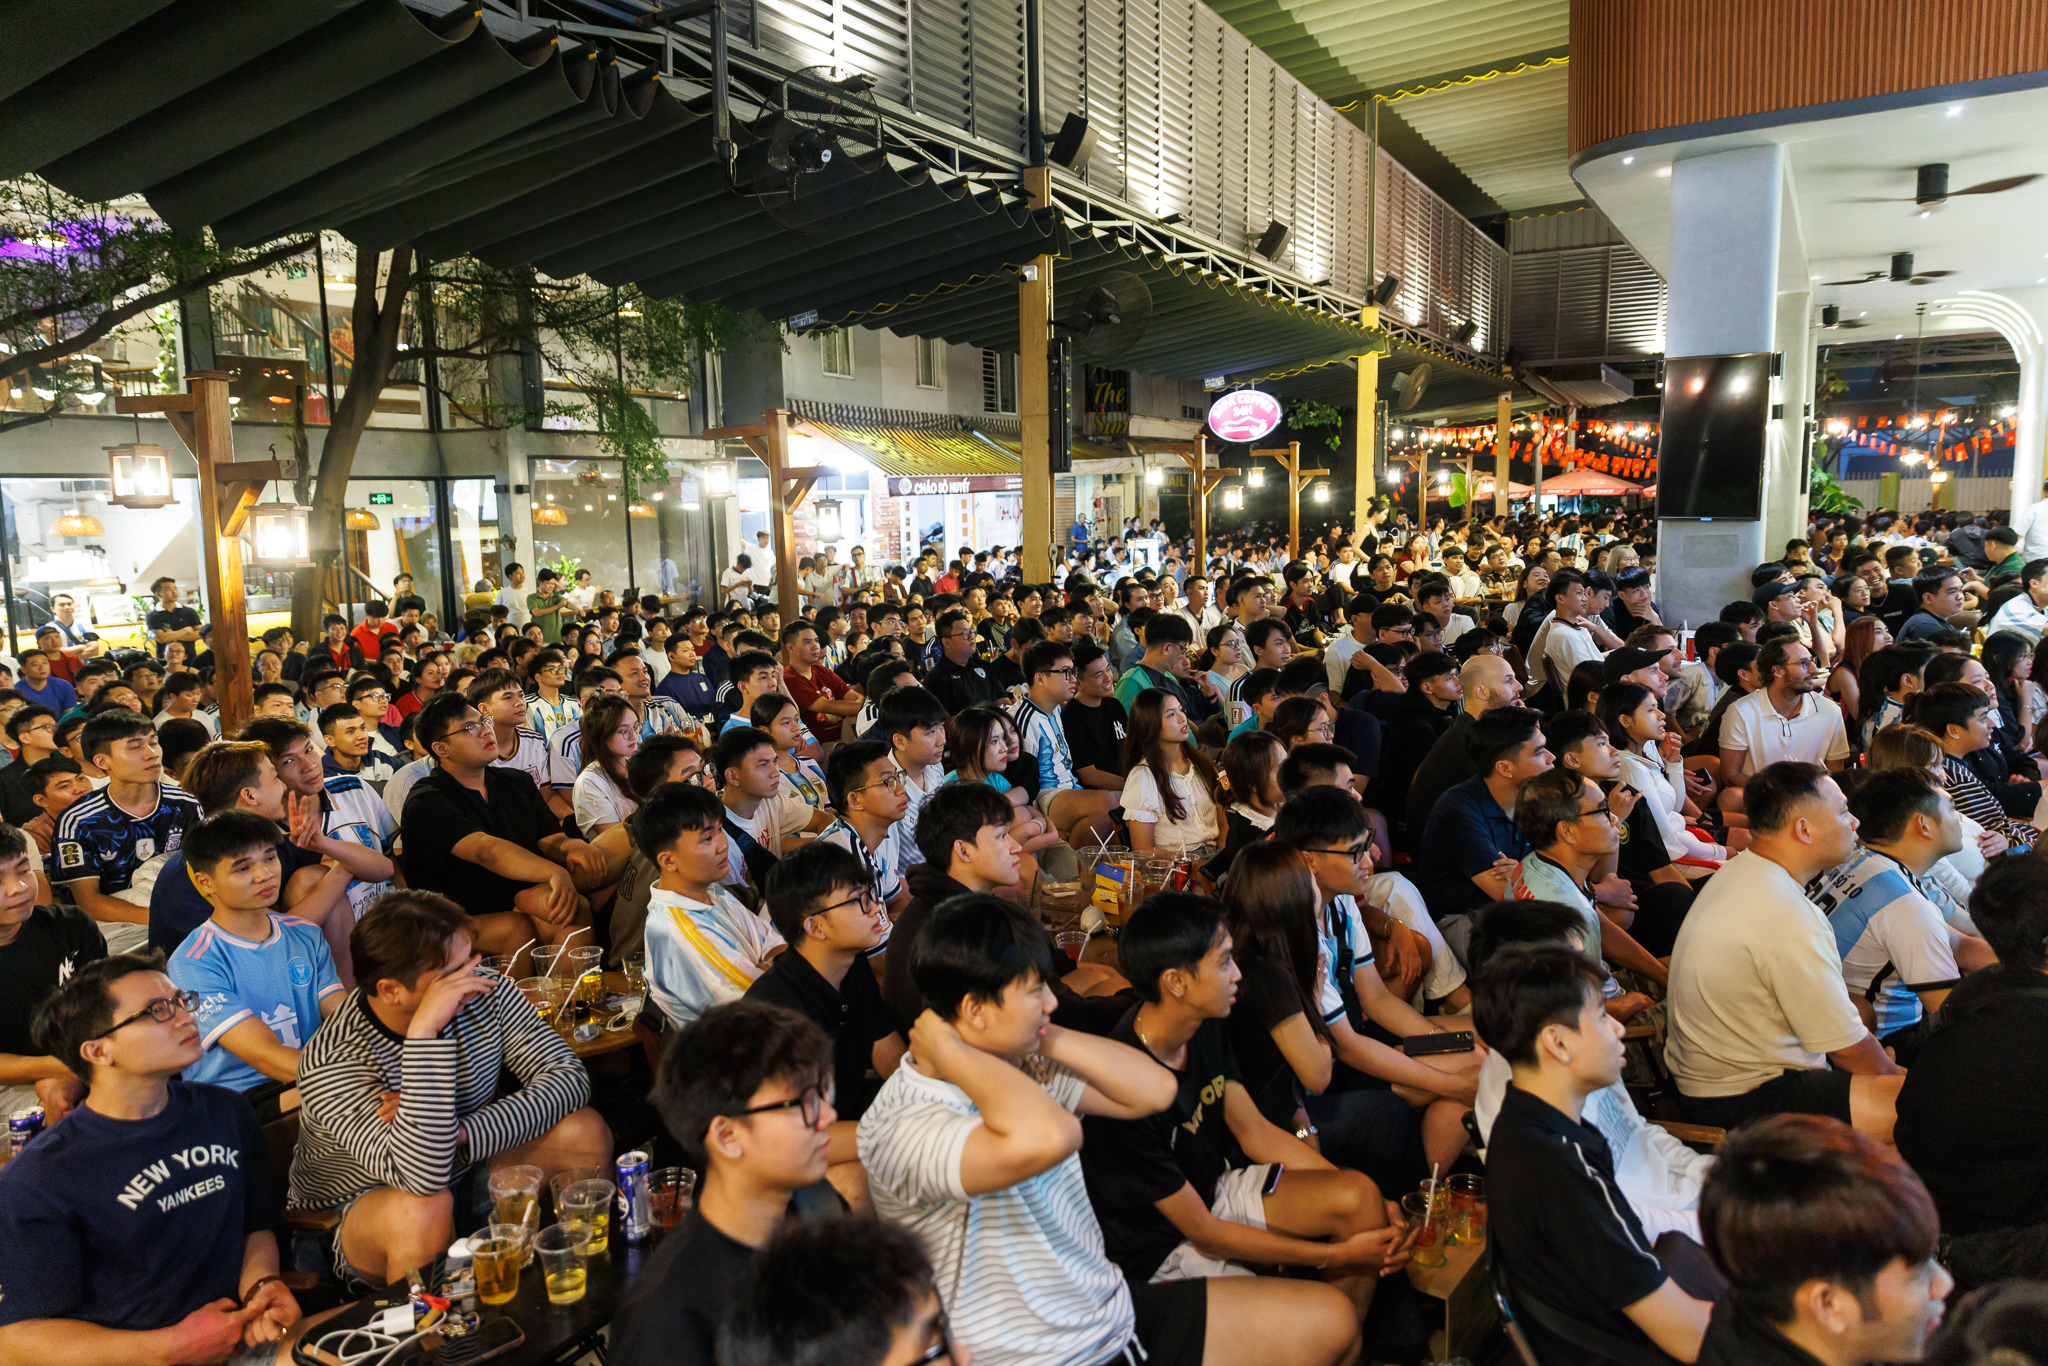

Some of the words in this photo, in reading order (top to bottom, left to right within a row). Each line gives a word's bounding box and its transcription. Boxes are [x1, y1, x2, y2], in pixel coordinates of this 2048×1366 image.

[1095, 382, 1125, 404] The
[1237, 394, 1275, 413] COFFEE
[1233, 405, 1253, 417] 24H
[1095, 412, 1128, 435] Sun
[1842, 883, 1863, 899] 10
[117, 1159, 171, 1210] NEW
[171, 1144, 239, 1169] YORK
[157, 1175, 225, 1212] YANKEES
